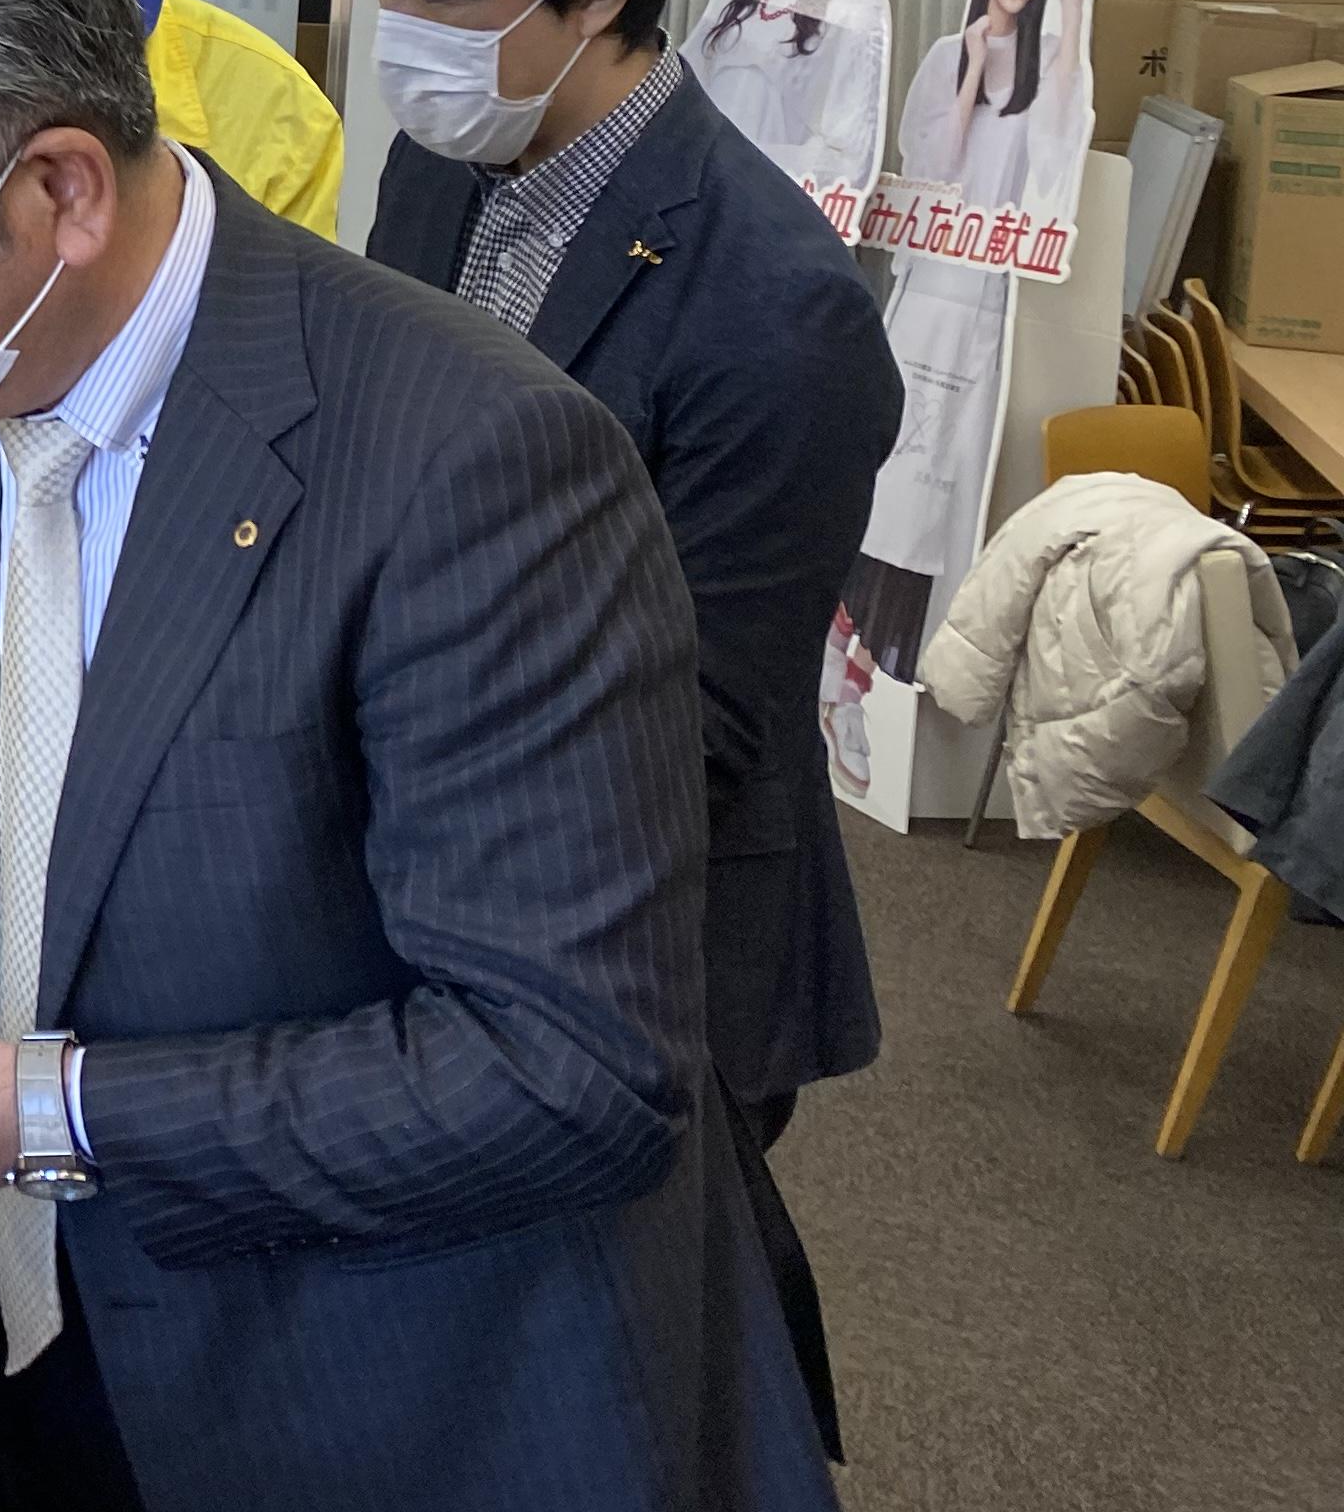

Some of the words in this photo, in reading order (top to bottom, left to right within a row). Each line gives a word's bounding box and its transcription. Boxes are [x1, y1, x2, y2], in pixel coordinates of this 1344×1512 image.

[804, 178, 858, 238] 血
[861, 192, 1068, 276] みんなの献血
